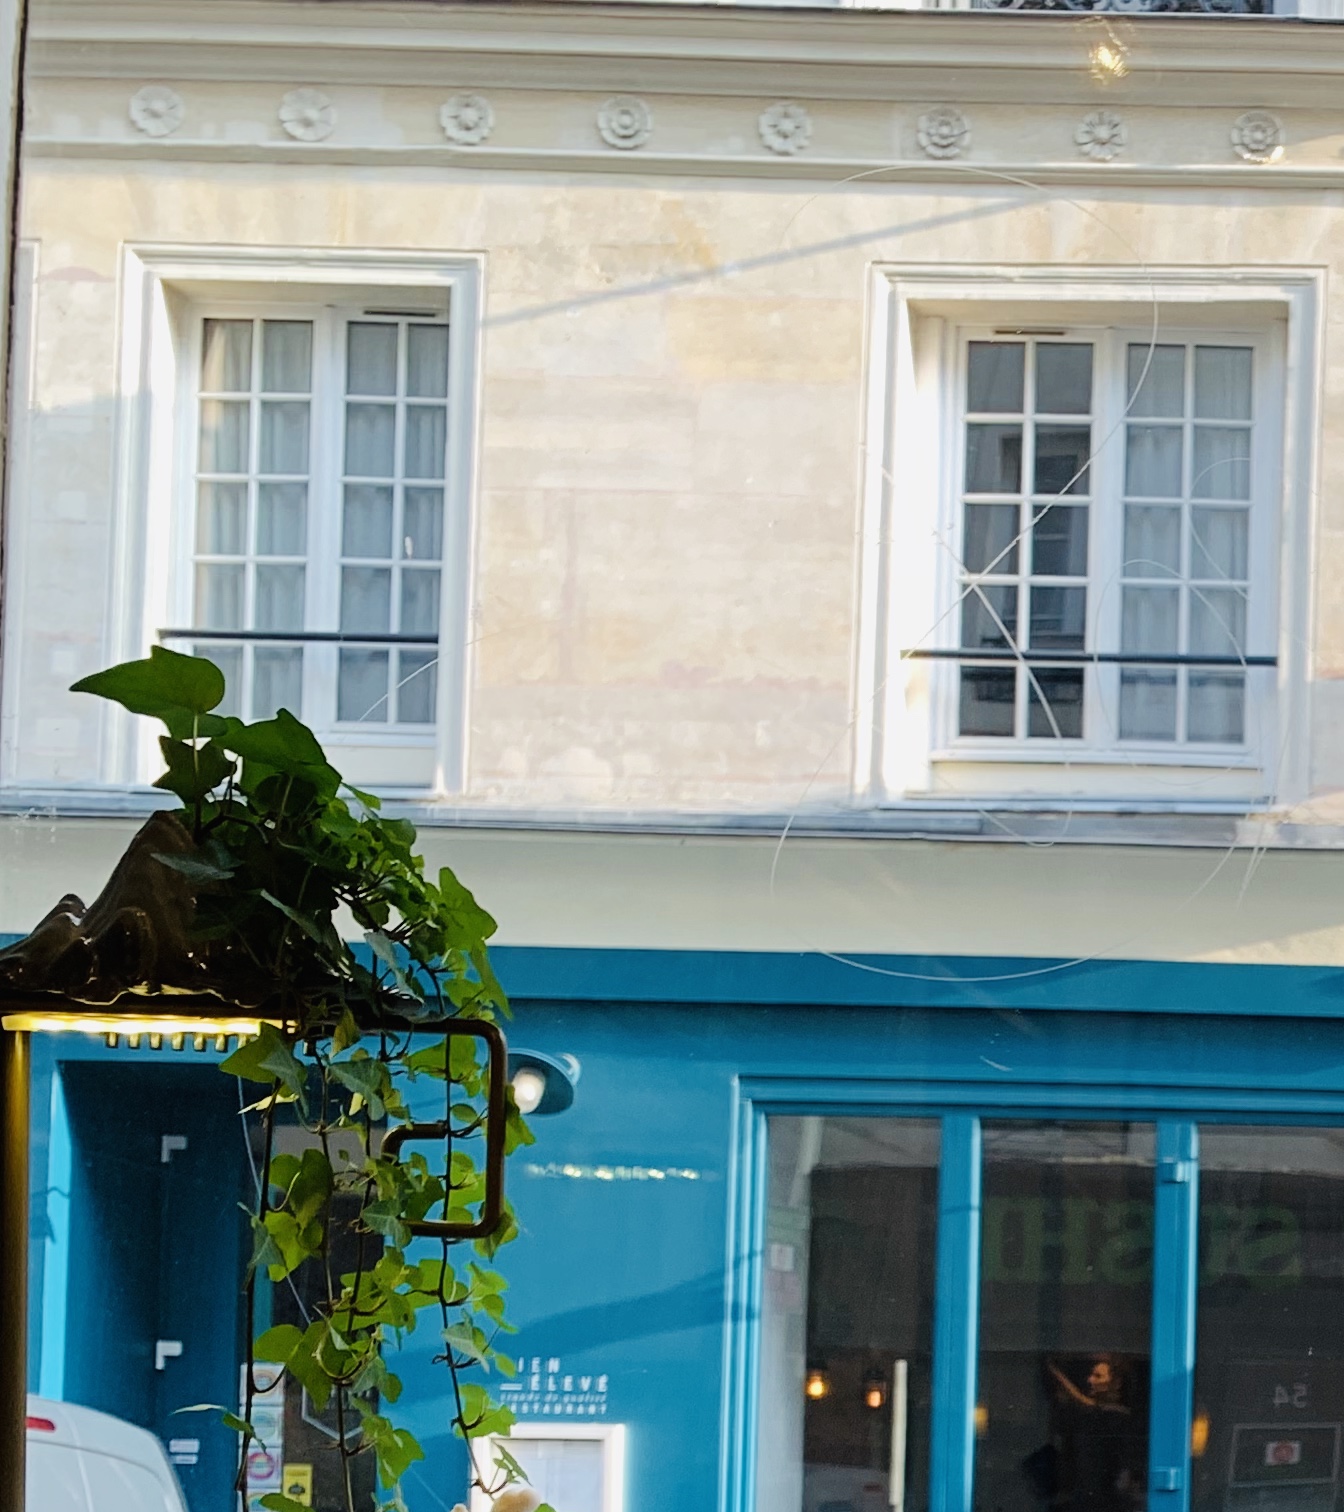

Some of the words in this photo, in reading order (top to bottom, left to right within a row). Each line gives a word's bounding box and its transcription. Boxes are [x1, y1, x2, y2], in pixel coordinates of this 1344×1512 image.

[518, 1357, 560, 1373] IEN
[530, 1373, 609, 1392] ÉLEVÉ
[510, 1403, 607, 1414] ESTAURANT
